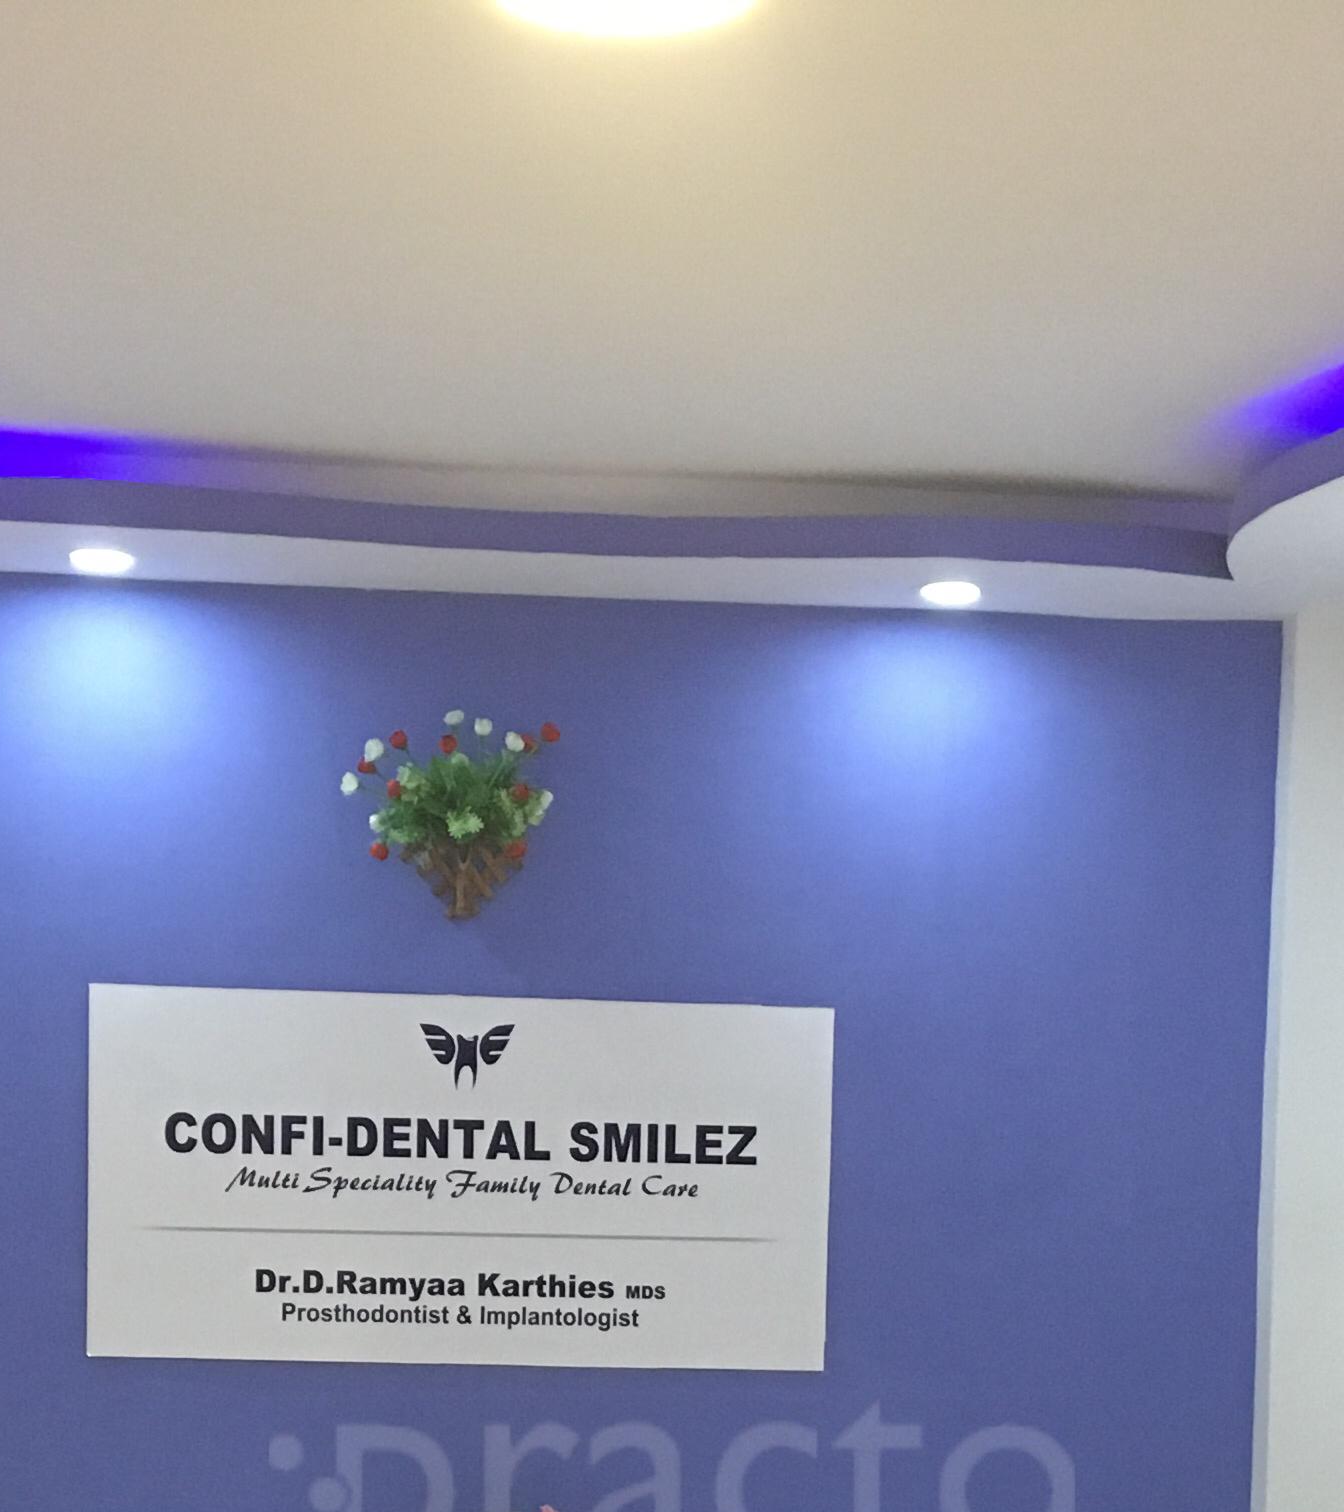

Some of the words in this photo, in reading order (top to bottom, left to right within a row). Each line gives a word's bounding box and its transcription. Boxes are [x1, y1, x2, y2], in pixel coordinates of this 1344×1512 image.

[164, 1111, 551, 1162] CONFI-DENTAL
[569, 1121, 759, 1166] SMILEZ
[224, 1166, 300, 1193] Multi
[302, 1166, 437, 1200] Speciality
[445, 1169, 541, 1202] Family
[549, 1171, 632, 1197] Dental
[641, 1174, 698, 1198] Care
[255, 1268, 465, 1302] Dr.D.Ramyaa
[477, 1272, 615, 1299] Karthies
[625, 1285, 666, 1300] MDS
[281, 1302, 450, 1325] Prosthodontist
[456, 1304, 473, 1325] &
[480, 1305, 640, 1332] Implantologist
